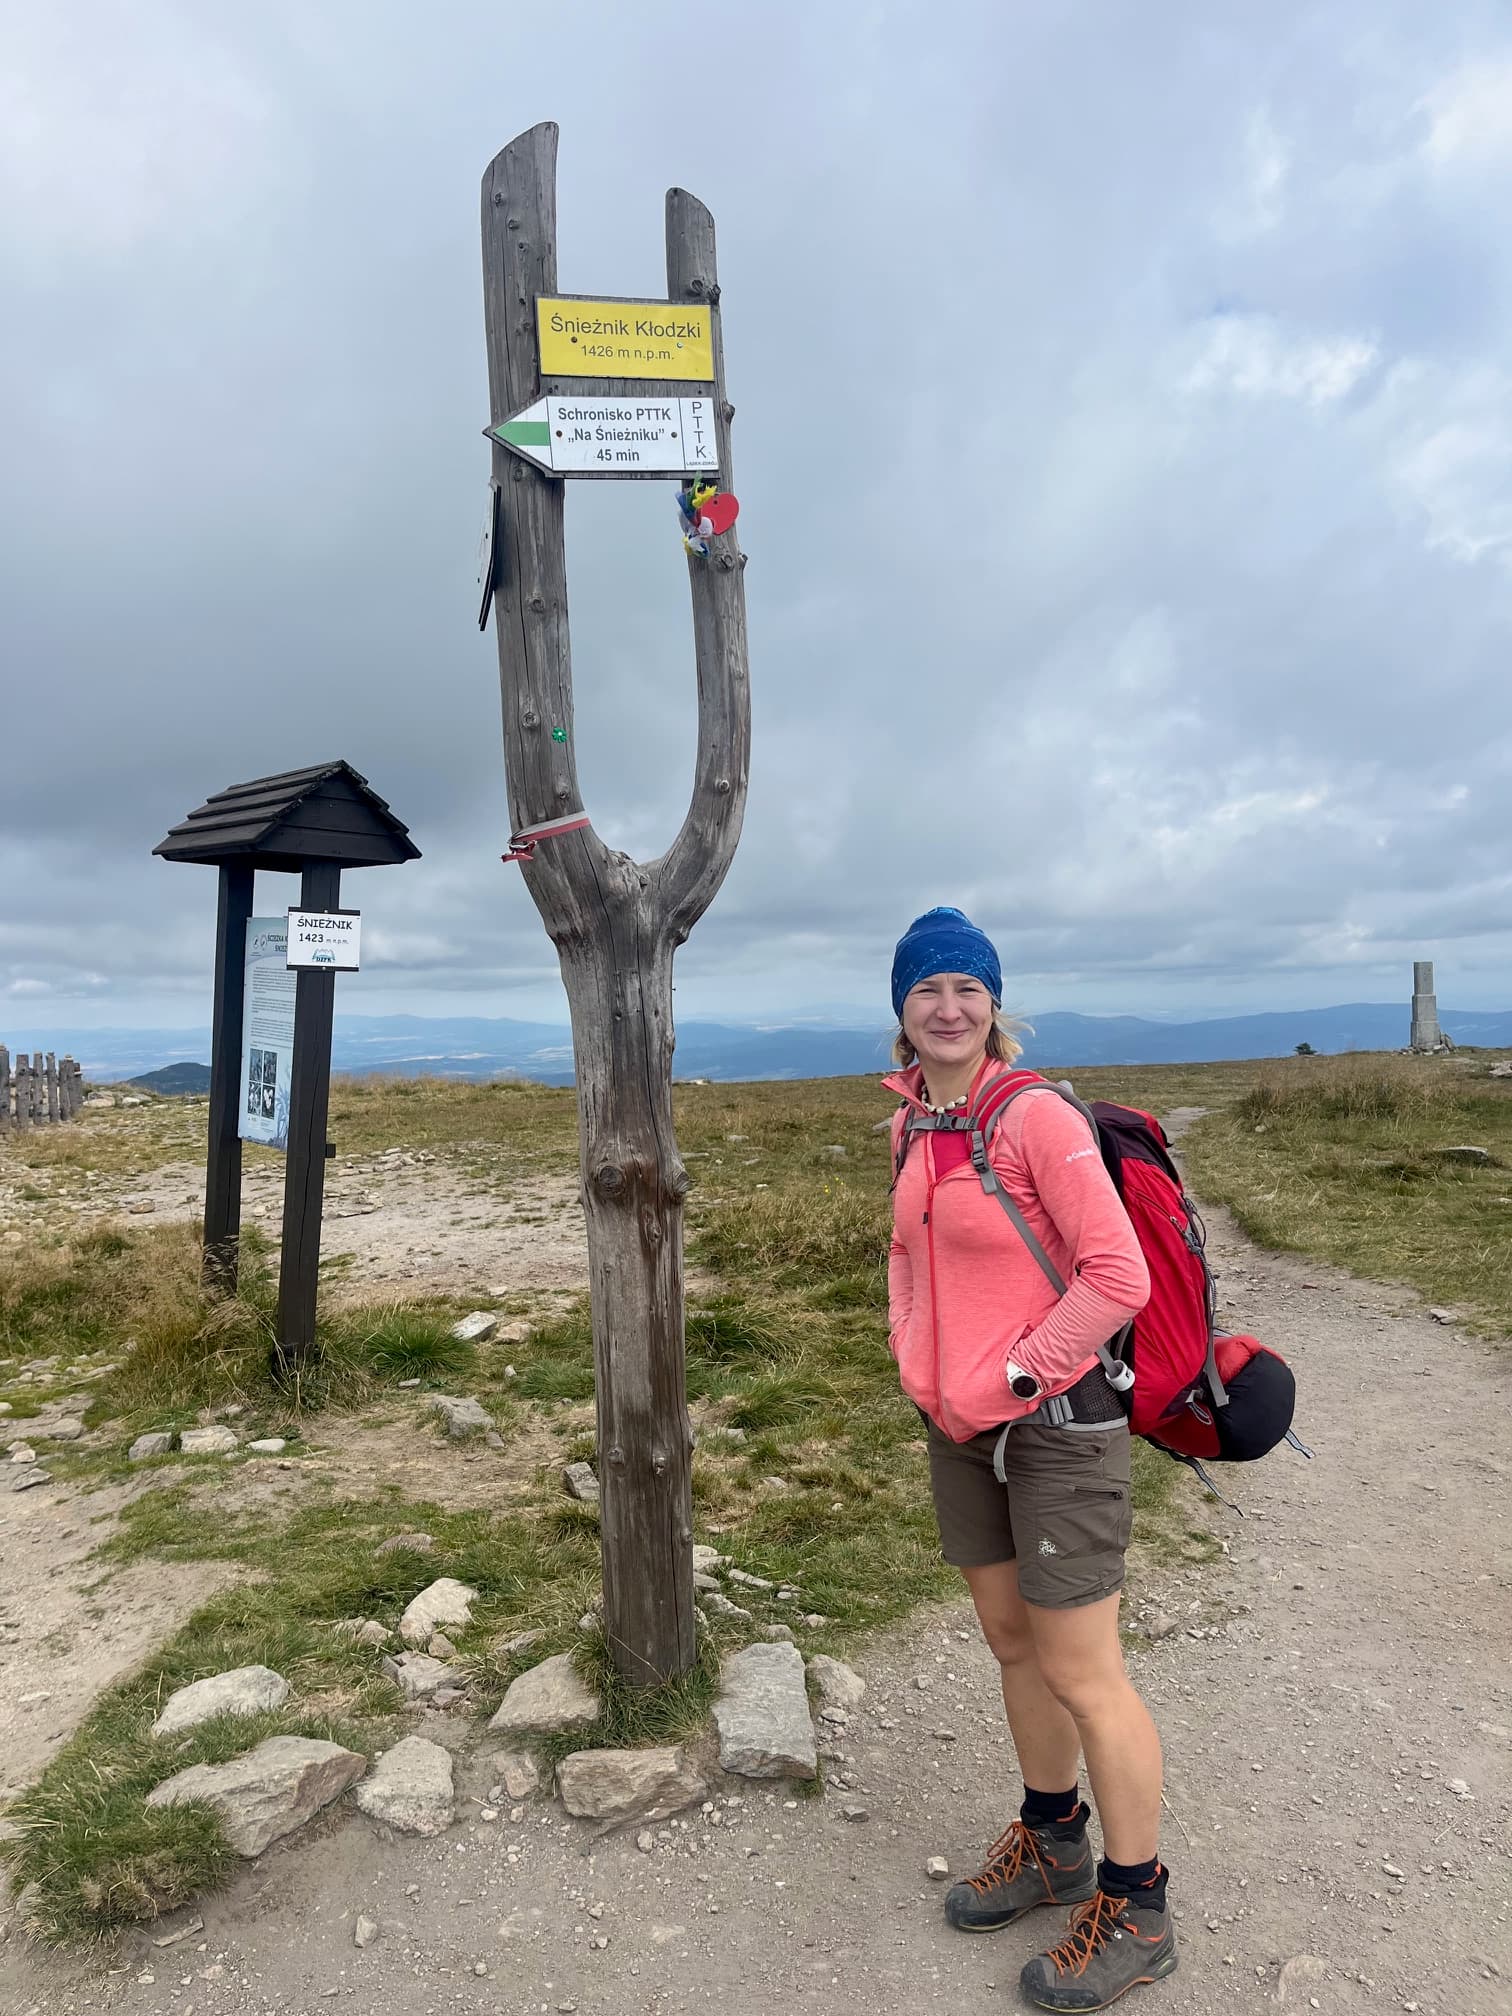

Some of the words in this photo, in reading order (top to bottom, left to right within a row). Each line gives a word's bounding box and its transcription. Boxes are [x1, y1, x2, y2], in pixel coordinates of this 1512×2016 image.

[550, 312, 630, 336] Śnieżnik
[635, 320, 702, 338] Kłodzki
[581, 345, 614, 358] 1426
[618, 349, 630, 358] m
[634, 349, 675, 361] n.p.m.
[558, 407, 632, 421] Schronisko
[636, 408, 672, 421] PTTK
[596, 448, 612, 462] 45
[616, 448, 640, 462] min
[297, 915, 353, 930] ŚNIEŻNIK
[299, 933, 324, 943] 1423
